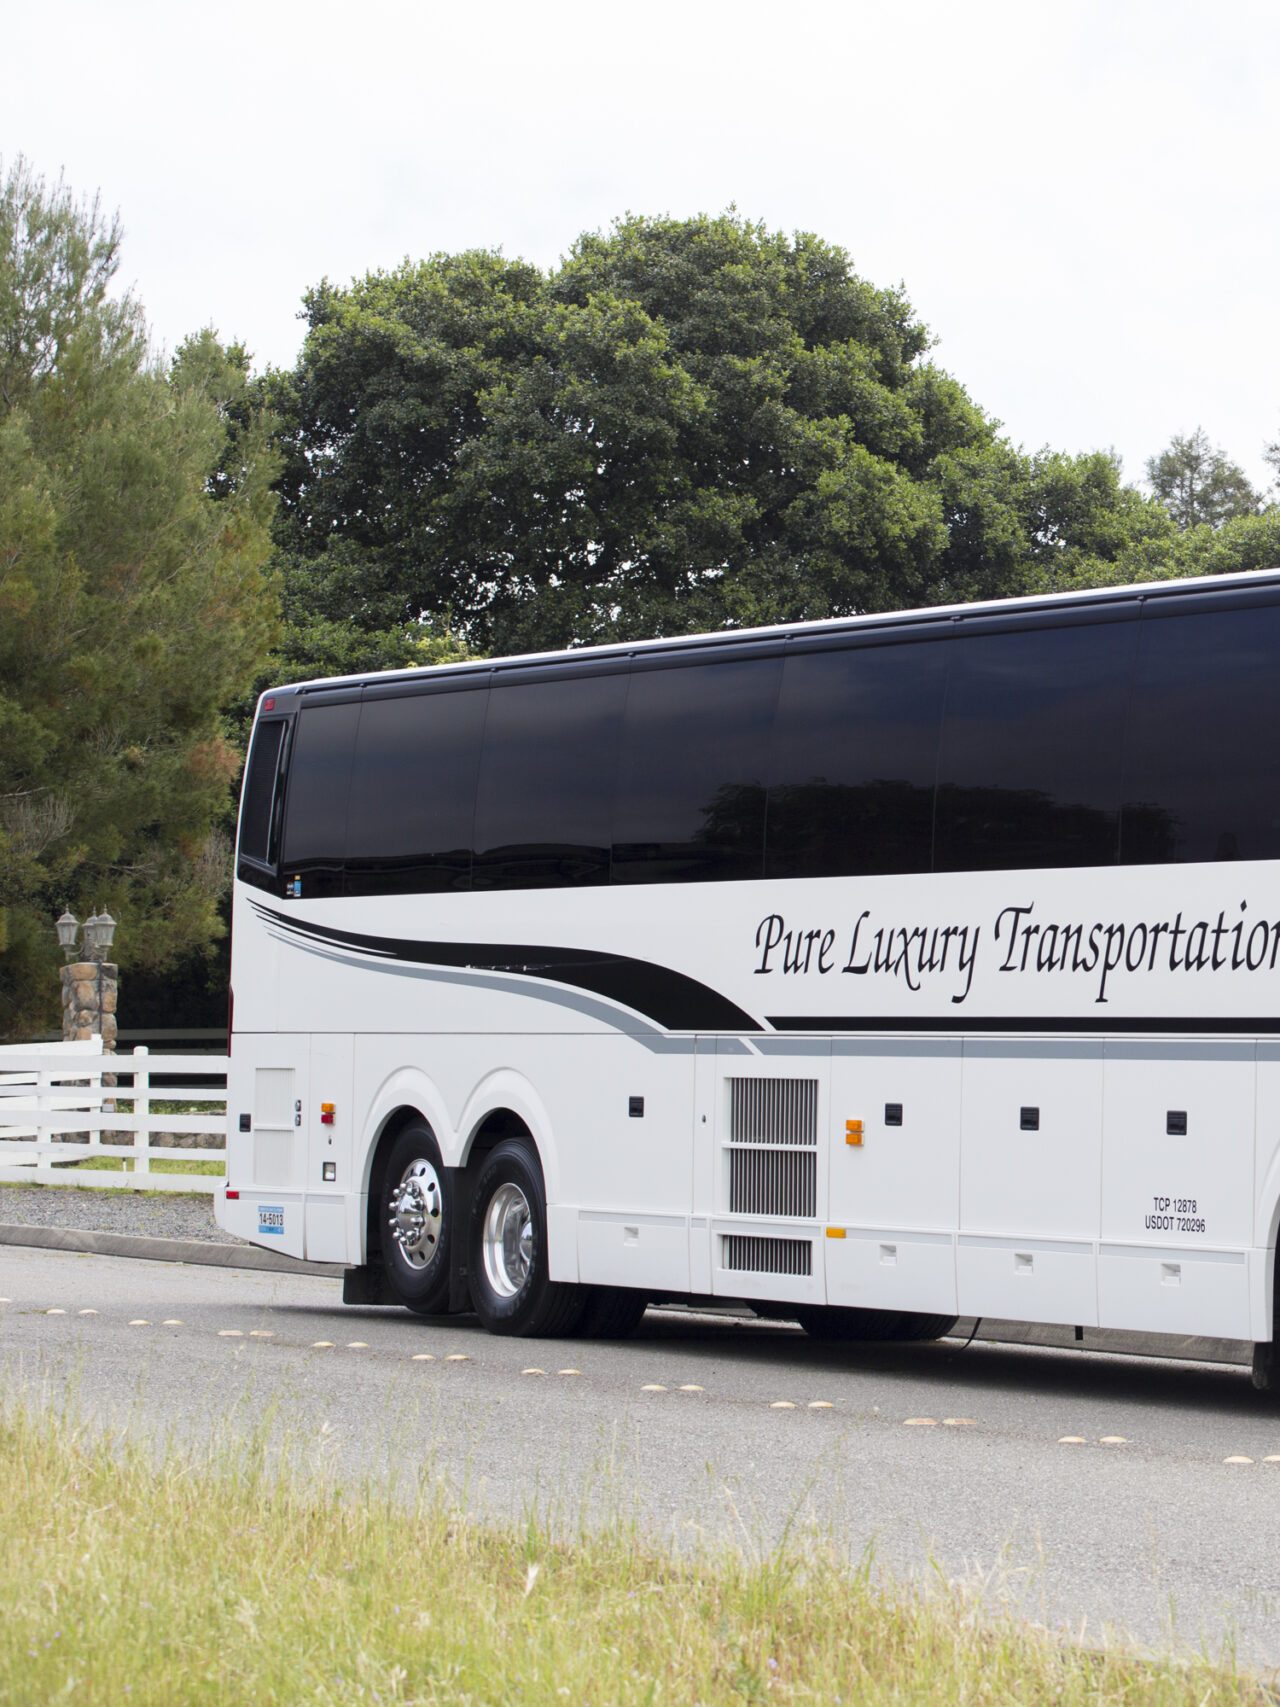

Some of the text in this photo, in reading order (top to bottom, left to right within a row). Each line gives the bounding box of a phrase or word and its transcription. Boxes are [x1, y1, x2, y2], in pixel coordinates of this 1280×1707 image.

[753, 913, 836, 975] Pure
[841, 910, 981, 1004] Luxury
[1153, 1196, 1197, 1214] TCP 12878
[259, 1213, 284, 1226] 14-5013
[1145, 1214, 1206, 1233] USDOT 720296
